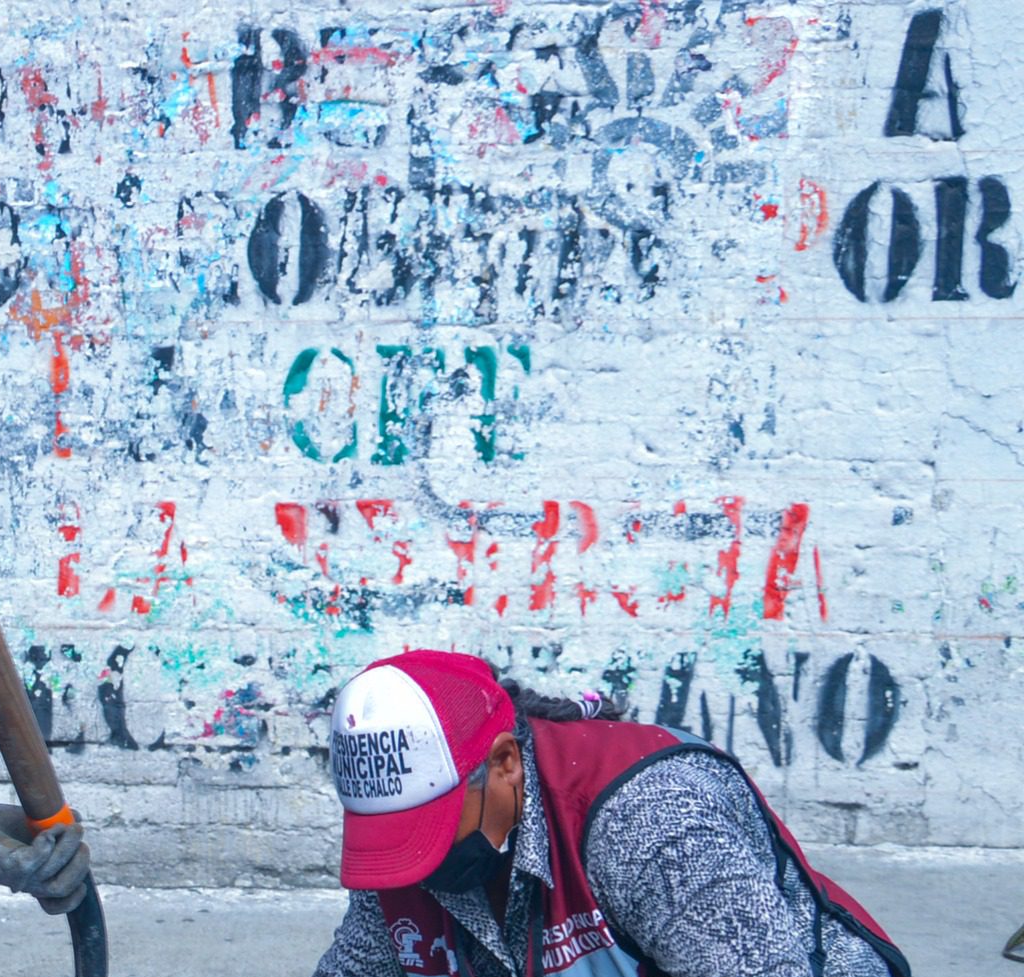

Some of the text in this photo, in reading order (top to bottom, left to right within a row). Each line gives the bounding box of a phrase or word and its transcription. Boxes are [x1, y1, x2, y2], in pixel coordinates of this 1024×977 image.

[833, 175, 1018, 303] OR
[352, 780, 363, 798] DE
[364, 776, 403, 798] CHALCO
